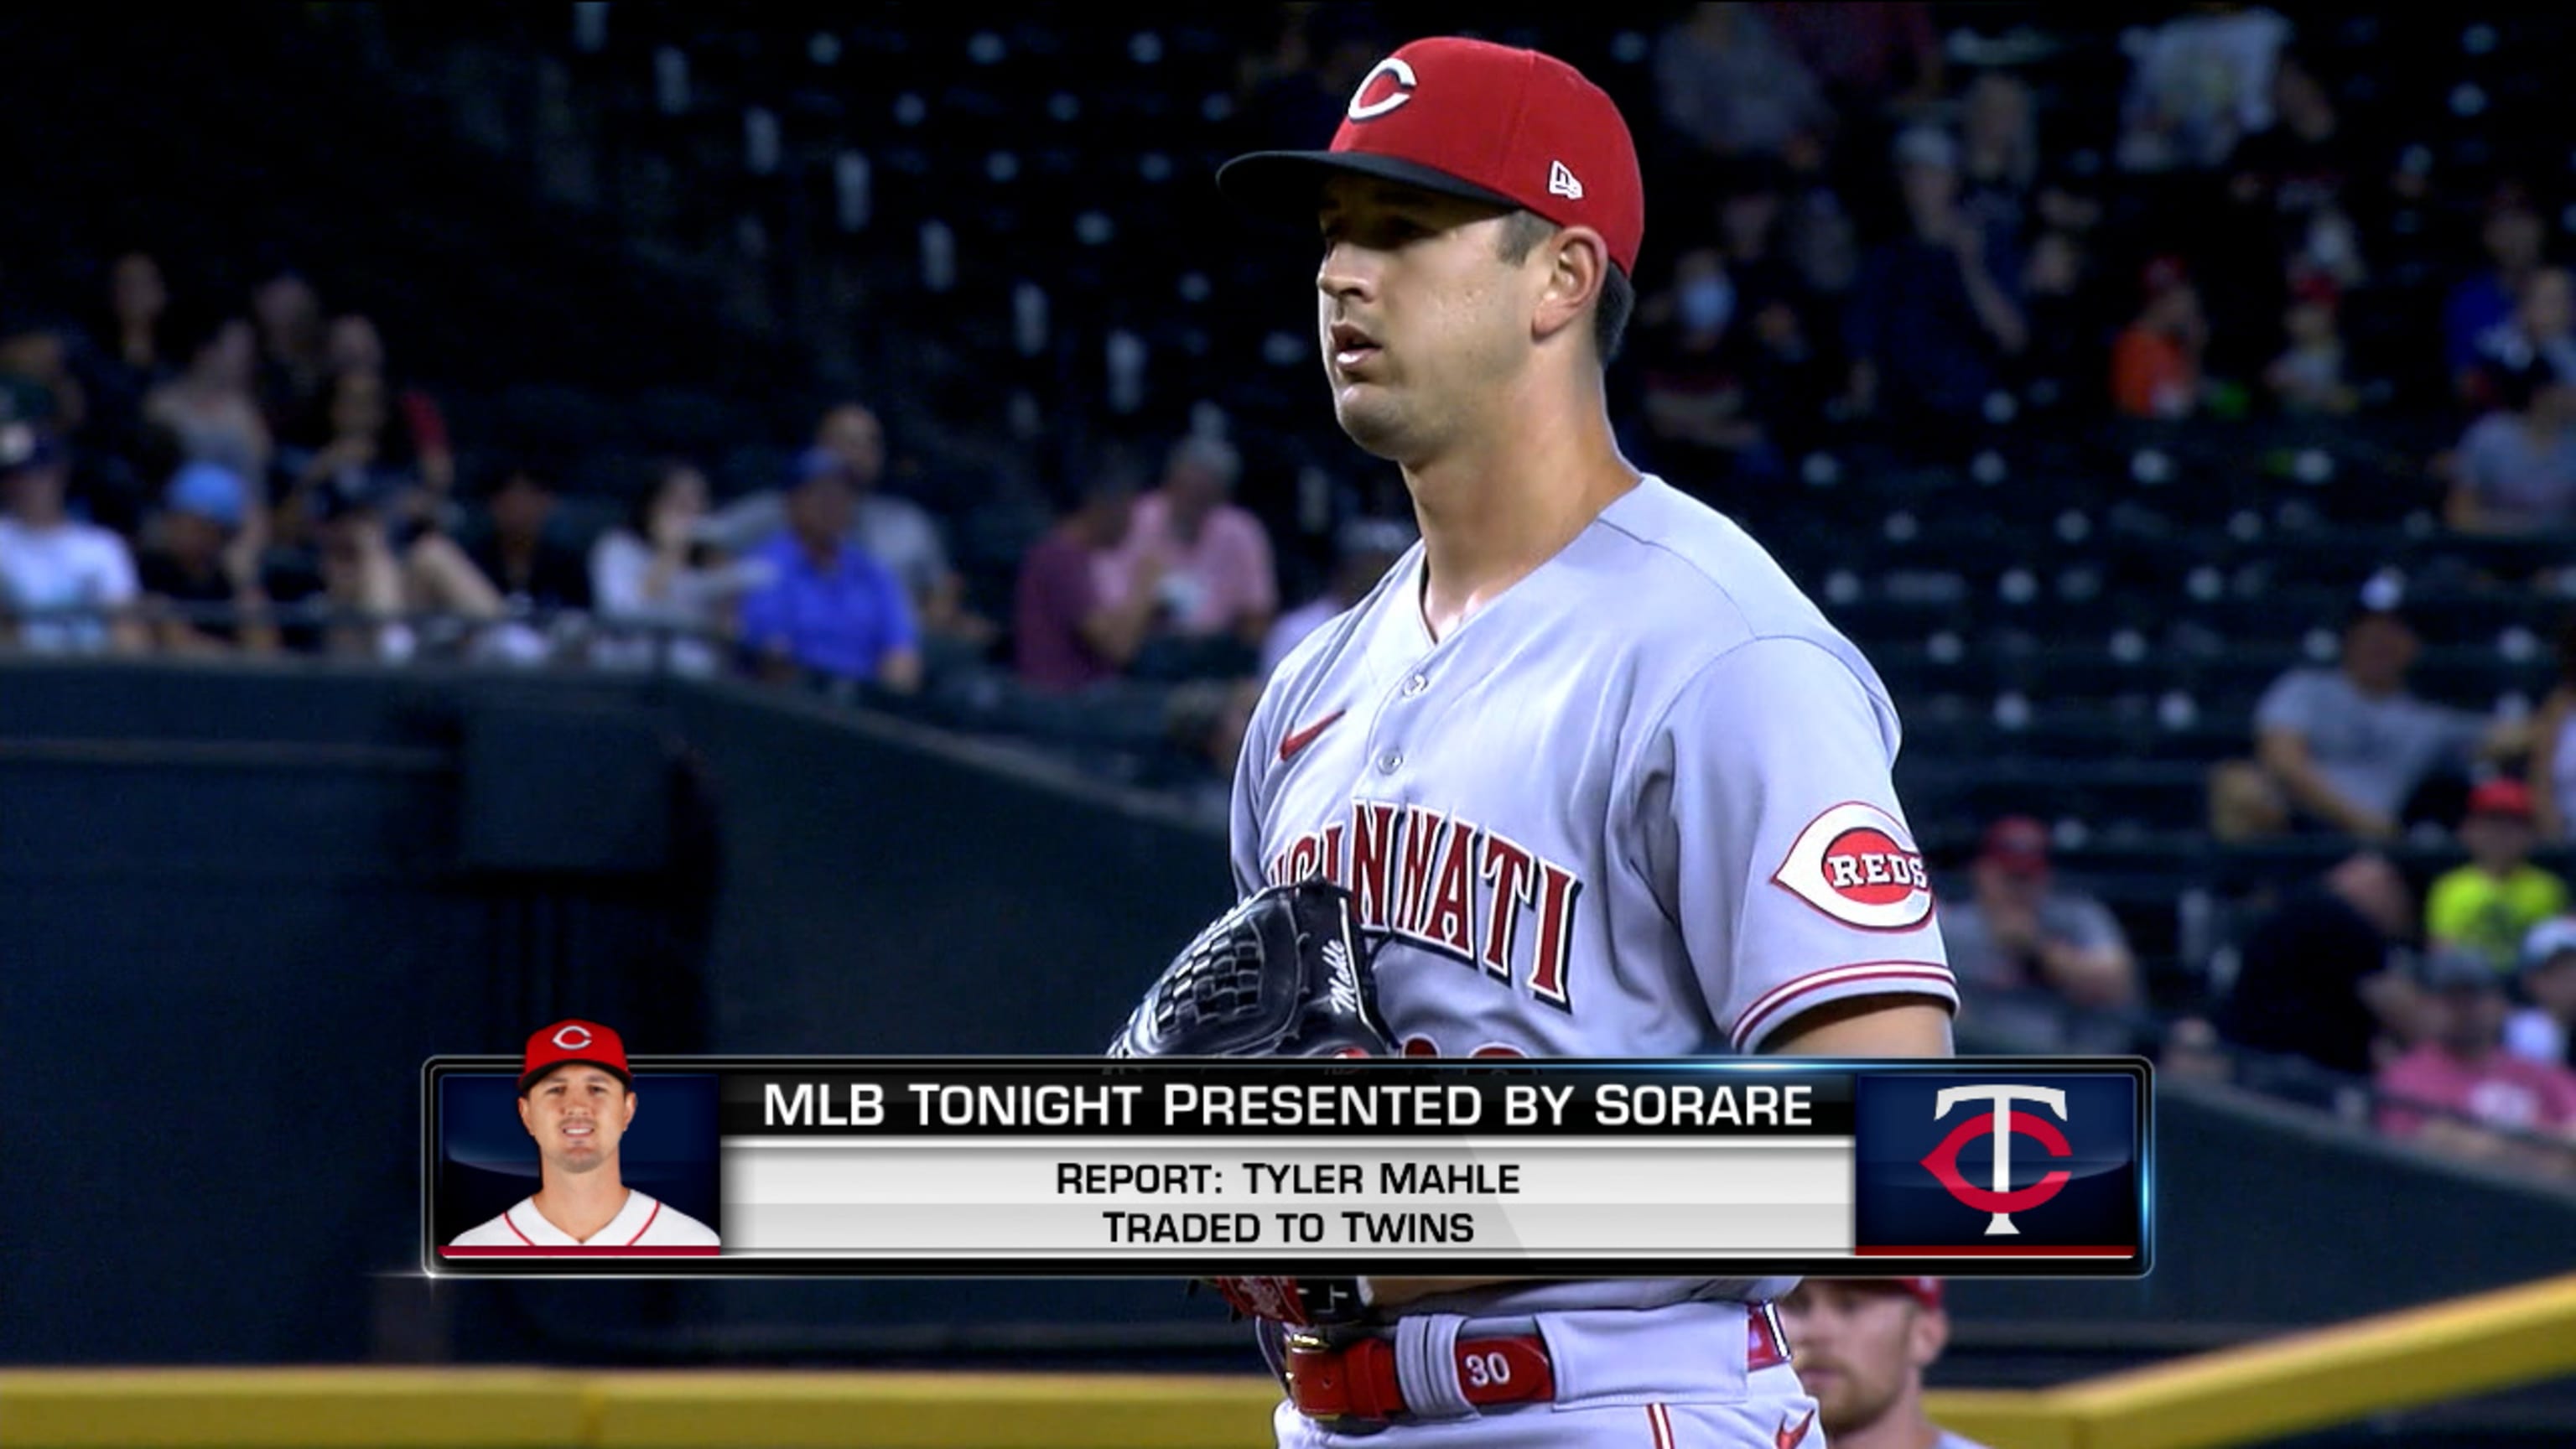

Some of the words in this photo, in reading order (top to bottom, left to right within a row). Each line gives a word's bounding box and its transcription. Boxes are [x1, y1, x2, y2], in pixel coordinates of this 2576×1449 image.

[1348, 58, 1417, 122] C
[1826, 852, 1928, 888] REDS
[1267, 798, 1583, 1014] CINNATI
[1466, 1352, 1510, 1387] 30
